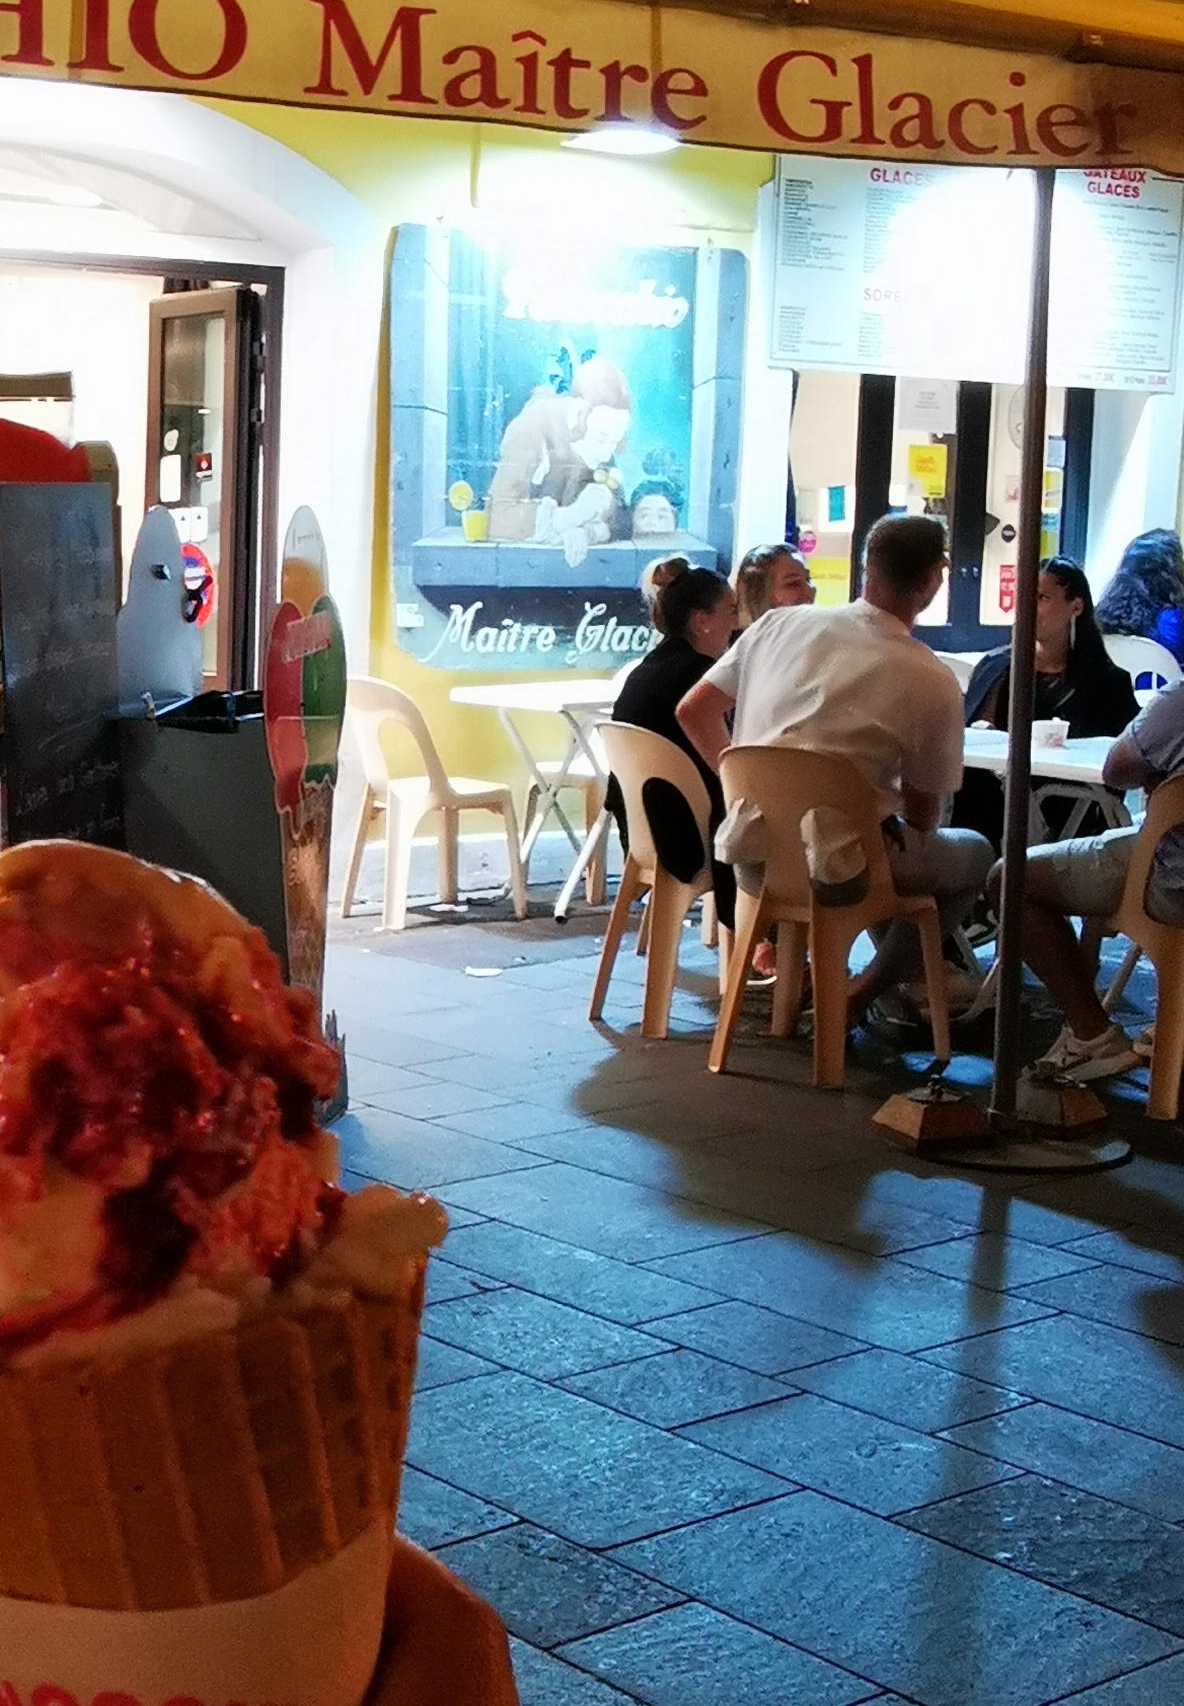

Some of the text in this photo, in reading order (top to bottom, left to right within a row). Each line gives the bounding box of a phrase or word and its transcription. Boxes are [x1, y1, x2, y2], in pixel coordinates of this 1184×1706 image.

[756, 48, 1134, 157] Glacier
[870, 167, 934, 186] GLACES
[1087, 181, 1140, 199] GLACES
[418, 601, 665, 664] Maître Glac
